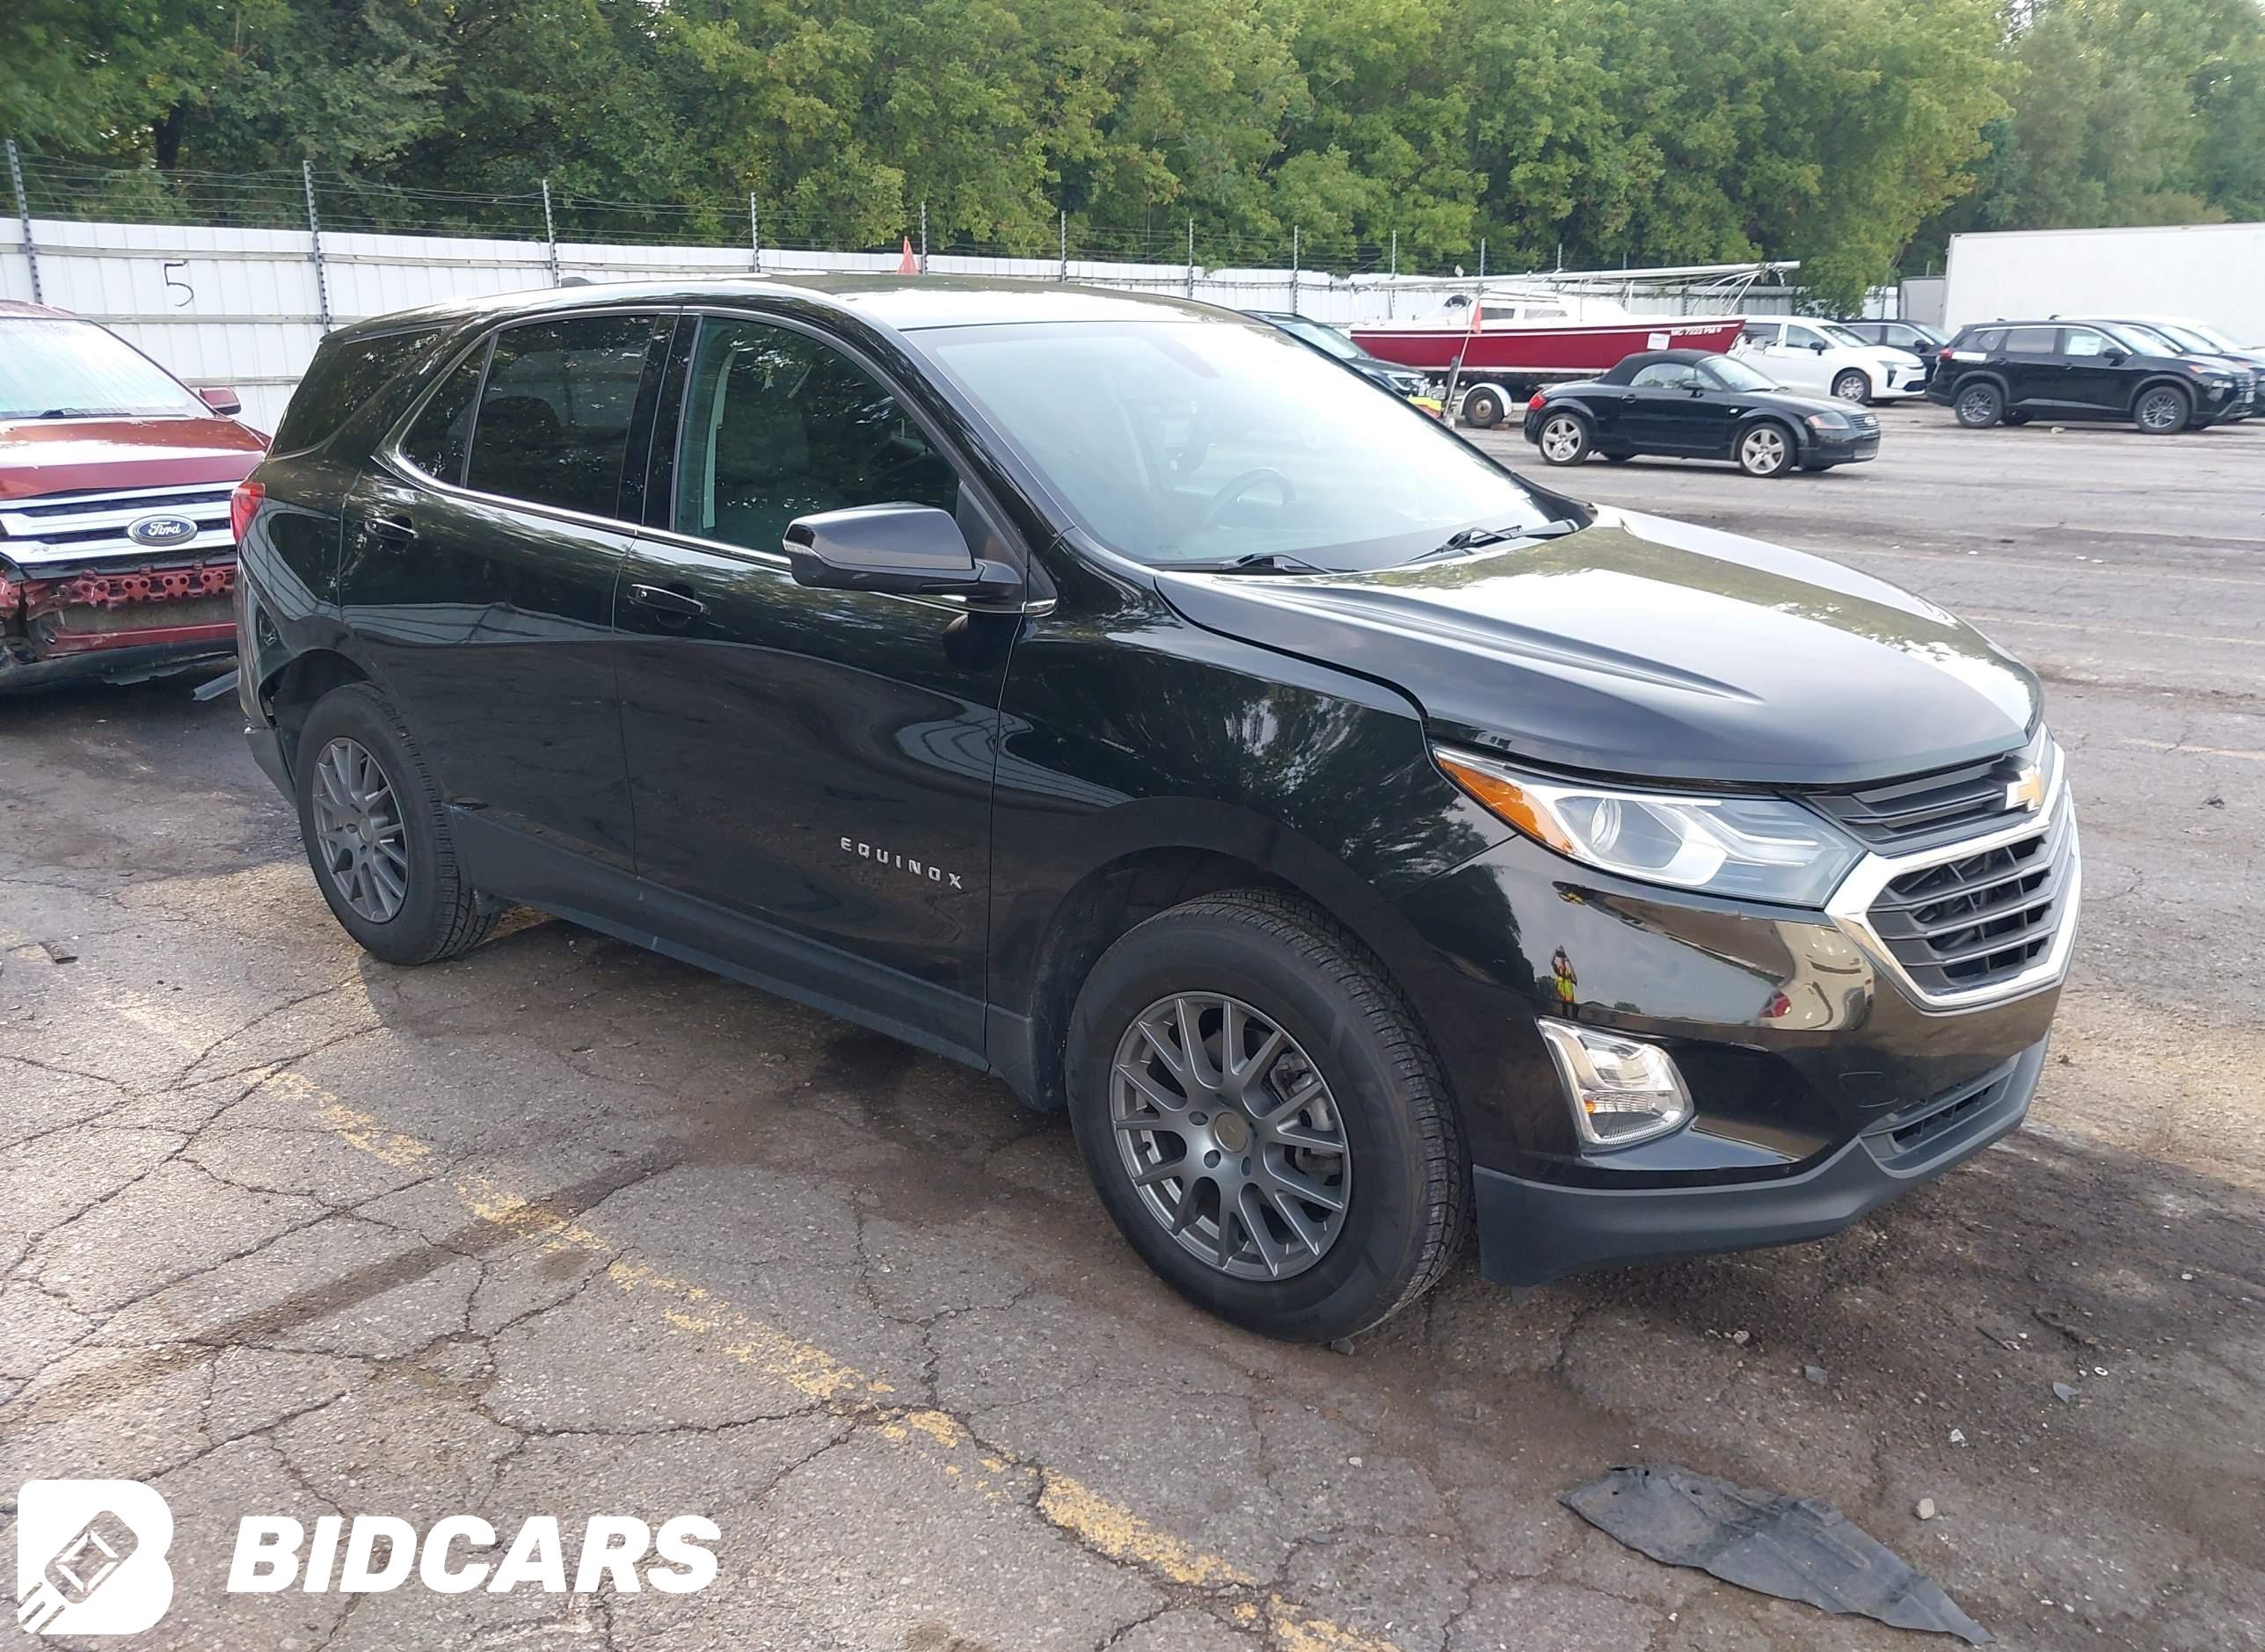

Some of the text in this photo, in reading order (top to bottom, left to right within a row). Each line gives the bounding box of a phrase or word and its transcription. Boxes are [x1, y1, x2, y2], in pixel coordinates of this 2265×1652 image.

[164, 259, 194, 307] 5
[148, 521, 182, 536] Ford
[840, 837, 963, 891] EQUINOX
